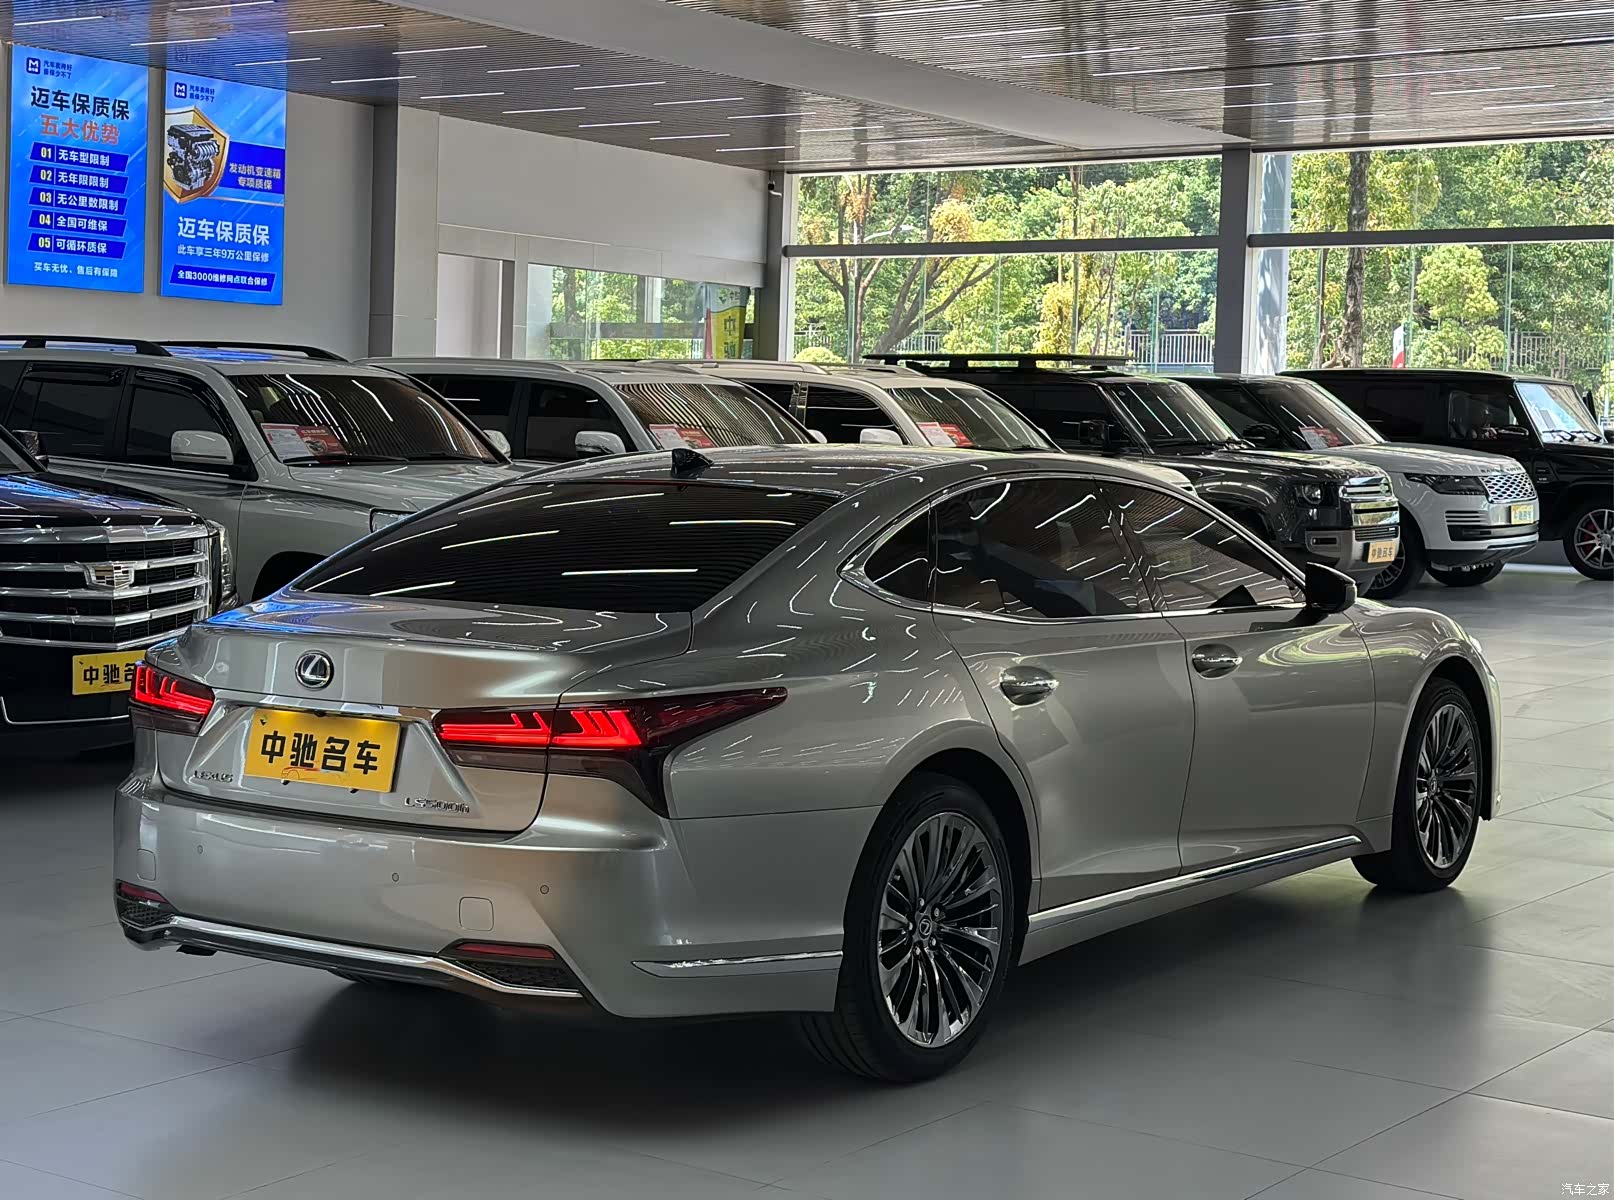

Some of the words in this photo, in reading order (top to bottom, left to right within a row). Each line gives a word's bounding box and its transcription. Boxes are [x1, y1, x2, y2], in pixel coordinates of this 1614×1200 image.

[30, 85, 130, 121] 迈车保质保
[40, 114, 120, 145] 五大优势
[40, 147, 52, 160] 01
[58, 149, 110, 167] 无车型限制
[40, 169, 52, 181] 02
[57, 171, 109, 189] 无年限限制
[229, 162, 282, 180] 发动机变速箱
[237, 176, 273, 190] 专项质保
[39, 191, 52, 203] 03
[57, 193, 119, 211] 无公里数限制
[39, 213, 51, 226] 04
[56, 215, 108, 232] 全国可维保
[177, 215, 270, 246] 迈车保质保
[38, 236, 51, 249] 05
[56, 238, 107, 254] 可循环质保
[260, 730, 381, 775] 中驰名车
